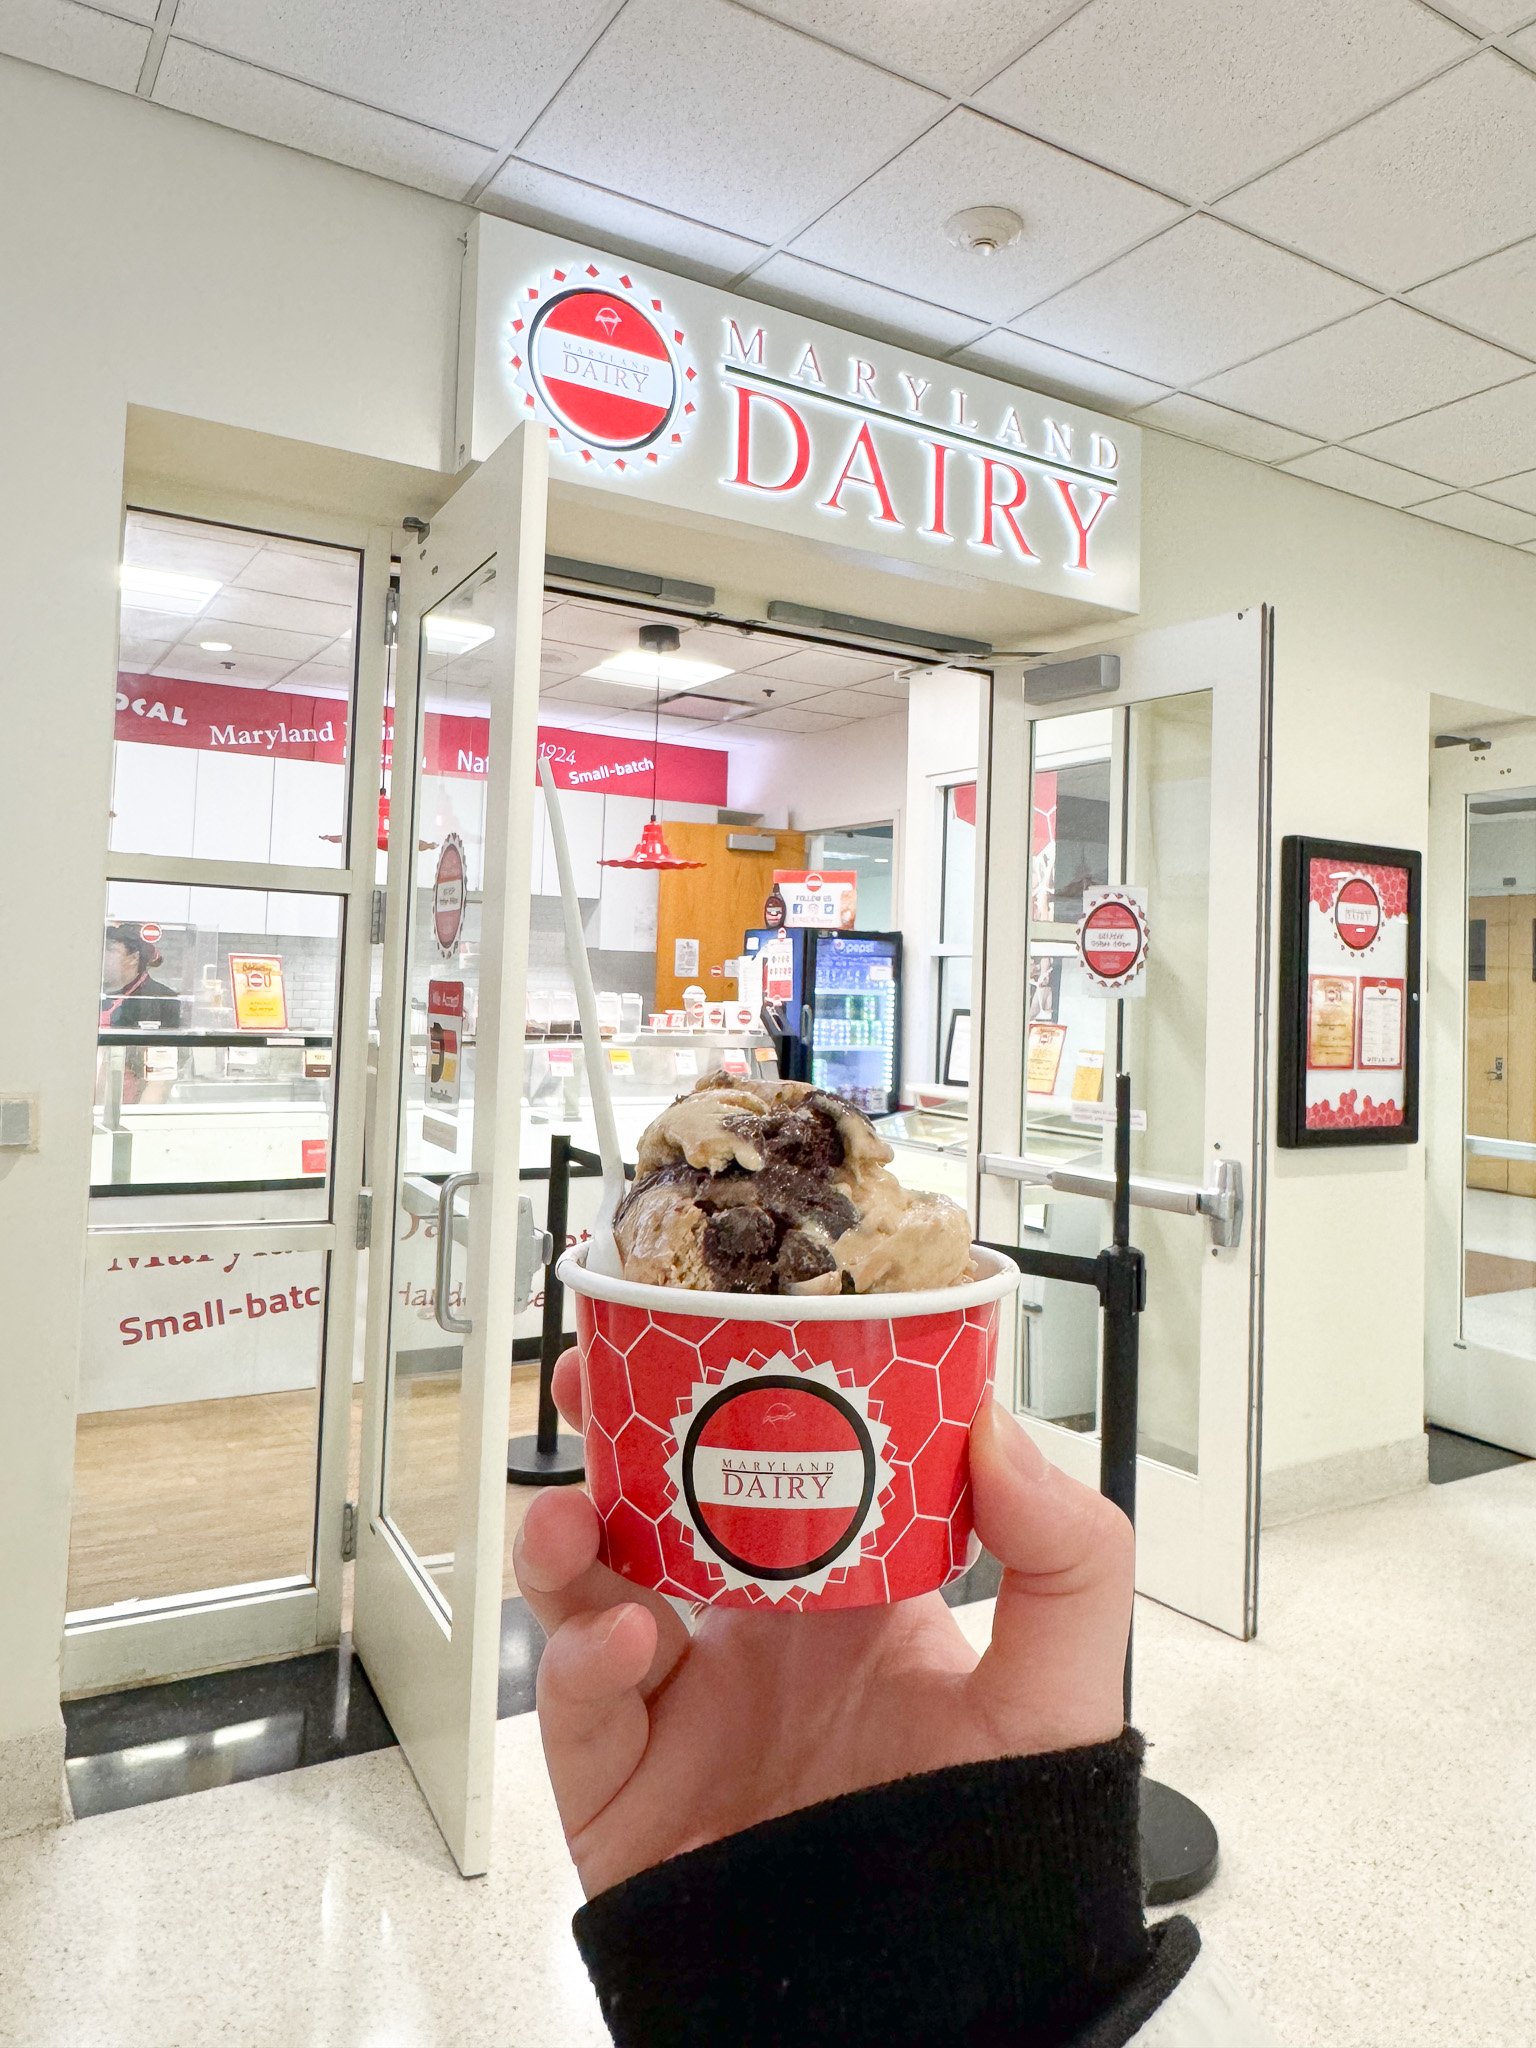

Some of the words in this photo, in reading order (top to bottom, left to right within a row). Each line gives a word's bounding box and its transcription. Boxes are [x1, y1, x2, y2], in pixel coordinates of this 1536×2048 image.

[563, 341, 650, 373] MARYLAND
[564, 354, 648, 393] DAIRY
[721, 317, 1119, 472] MARYLAND
[719, 382, 1118, 577] DAIRY
[209, 721, 335, 750] Maryland
[538, 742, 577, 765] 1924
[568, 757, 655, 785] Small-batch
[846, 943, 875, 953] pepsi
[722, 1458, 835, 1472] MARYLAND
[723, 1473, 832, 1500] DAIRY
